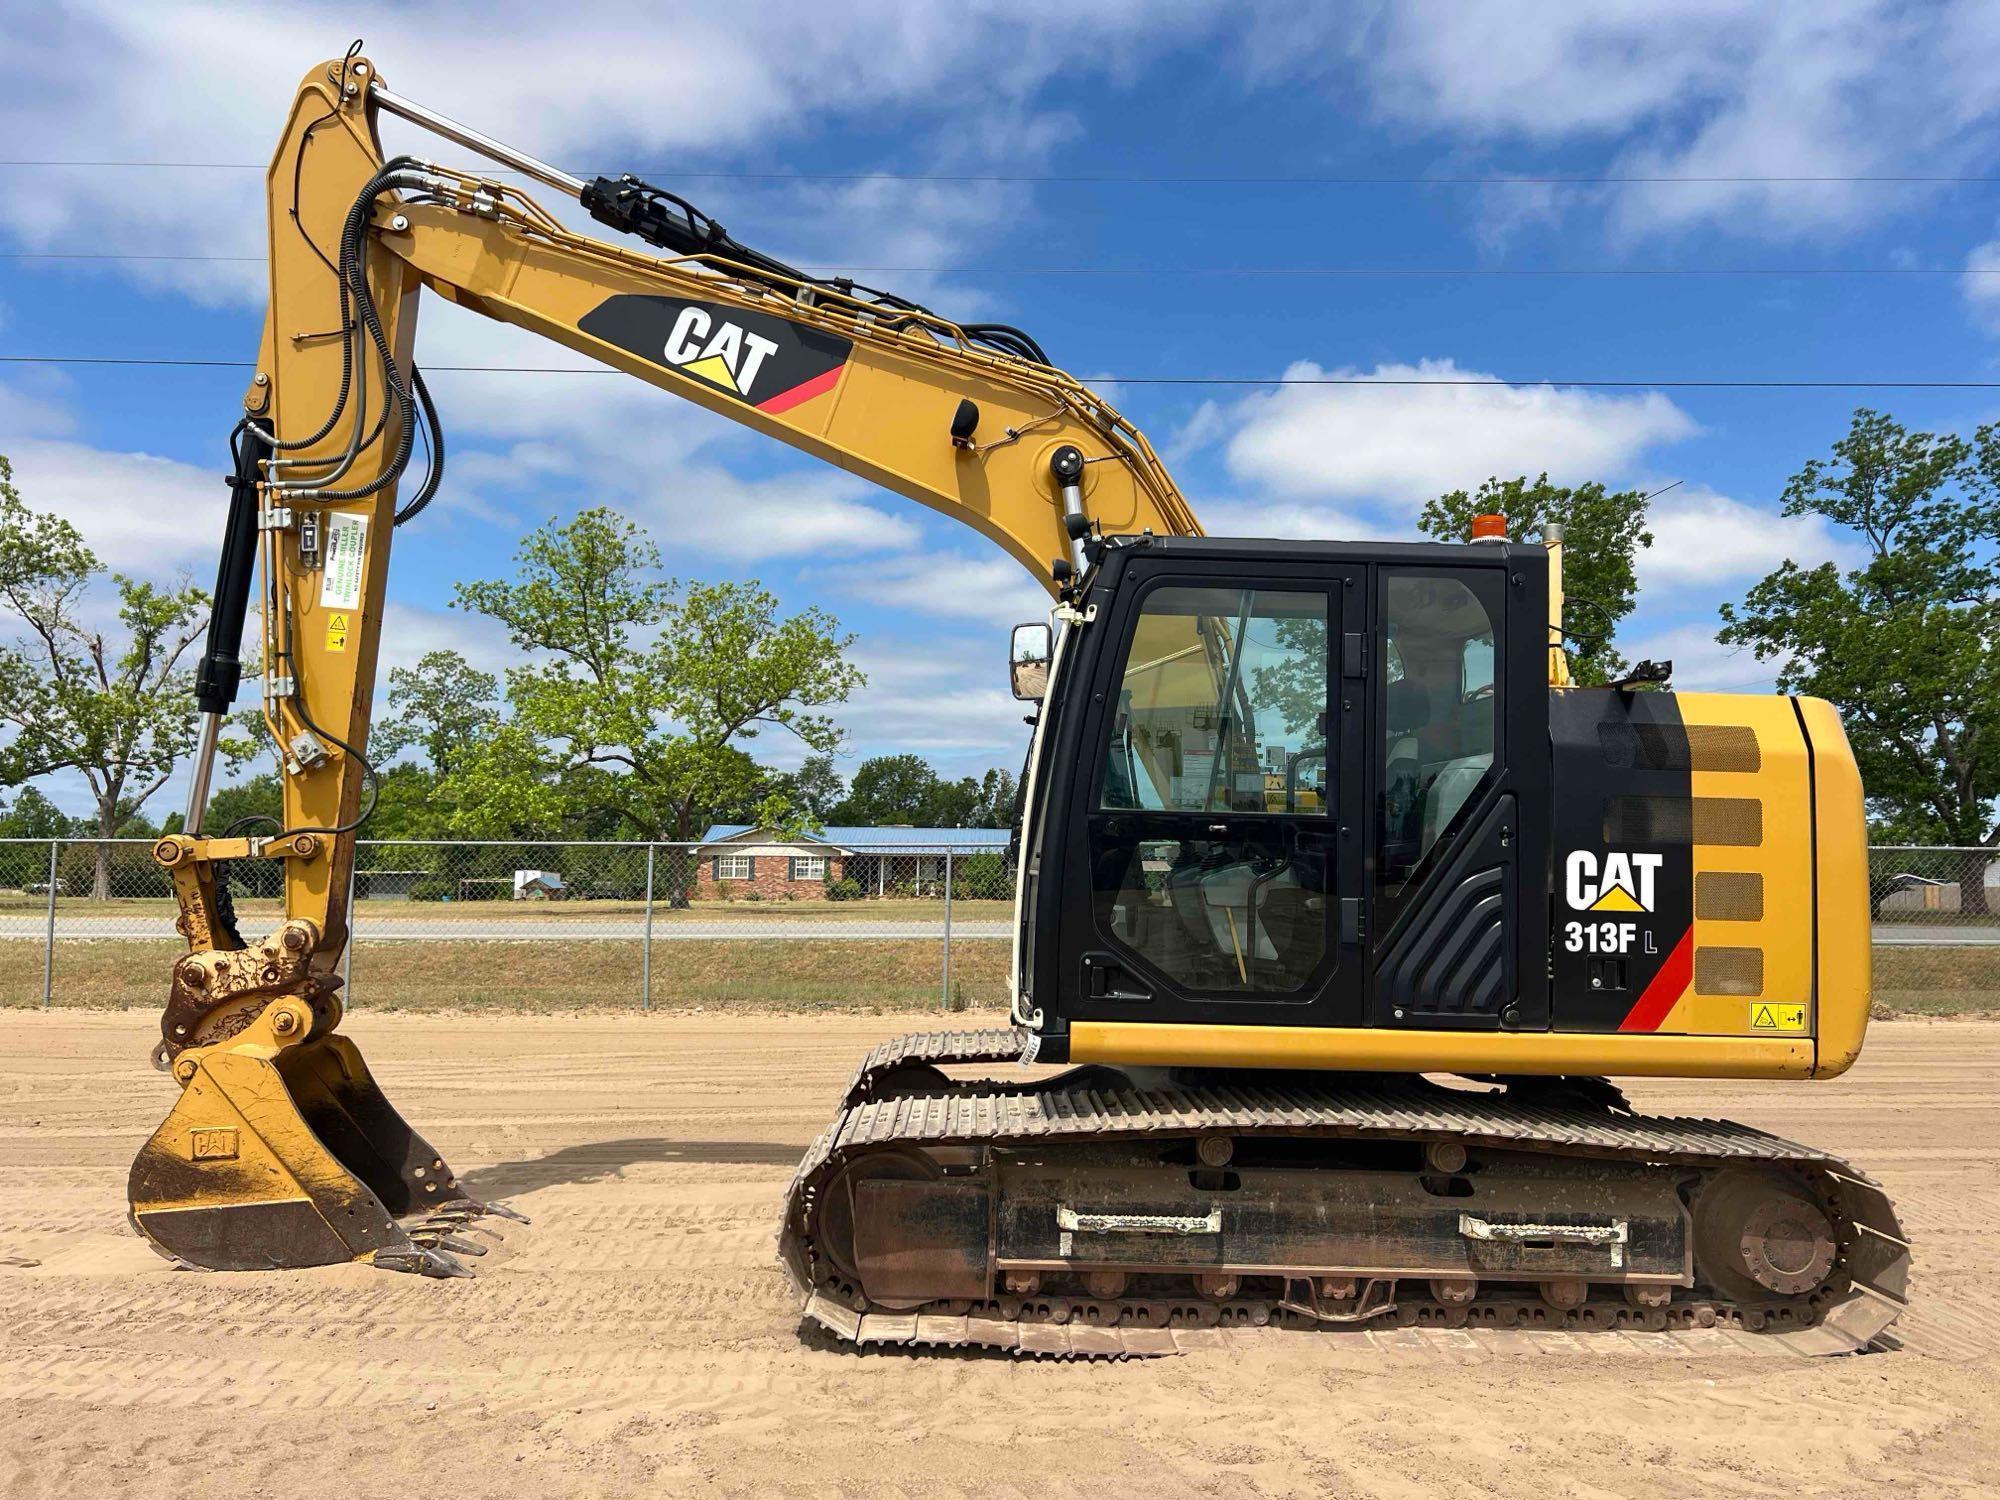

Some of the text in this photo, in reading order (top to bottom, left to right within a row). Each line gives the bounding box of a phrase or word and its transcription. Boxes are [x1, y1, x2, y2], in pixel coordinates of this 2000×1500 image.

[664, 306, 779, 396] CAT
[334, 557, 346, 596] GENUINE
[340, 526, 350, 556] MILLER
[343, 519, 359, 603] TWINLOCK COUPLER
[1566, 850, 1663, 912] CAT
[1565, 921, 1657, 953] 313F L
[192, 1130, 236, 1157] CAT
